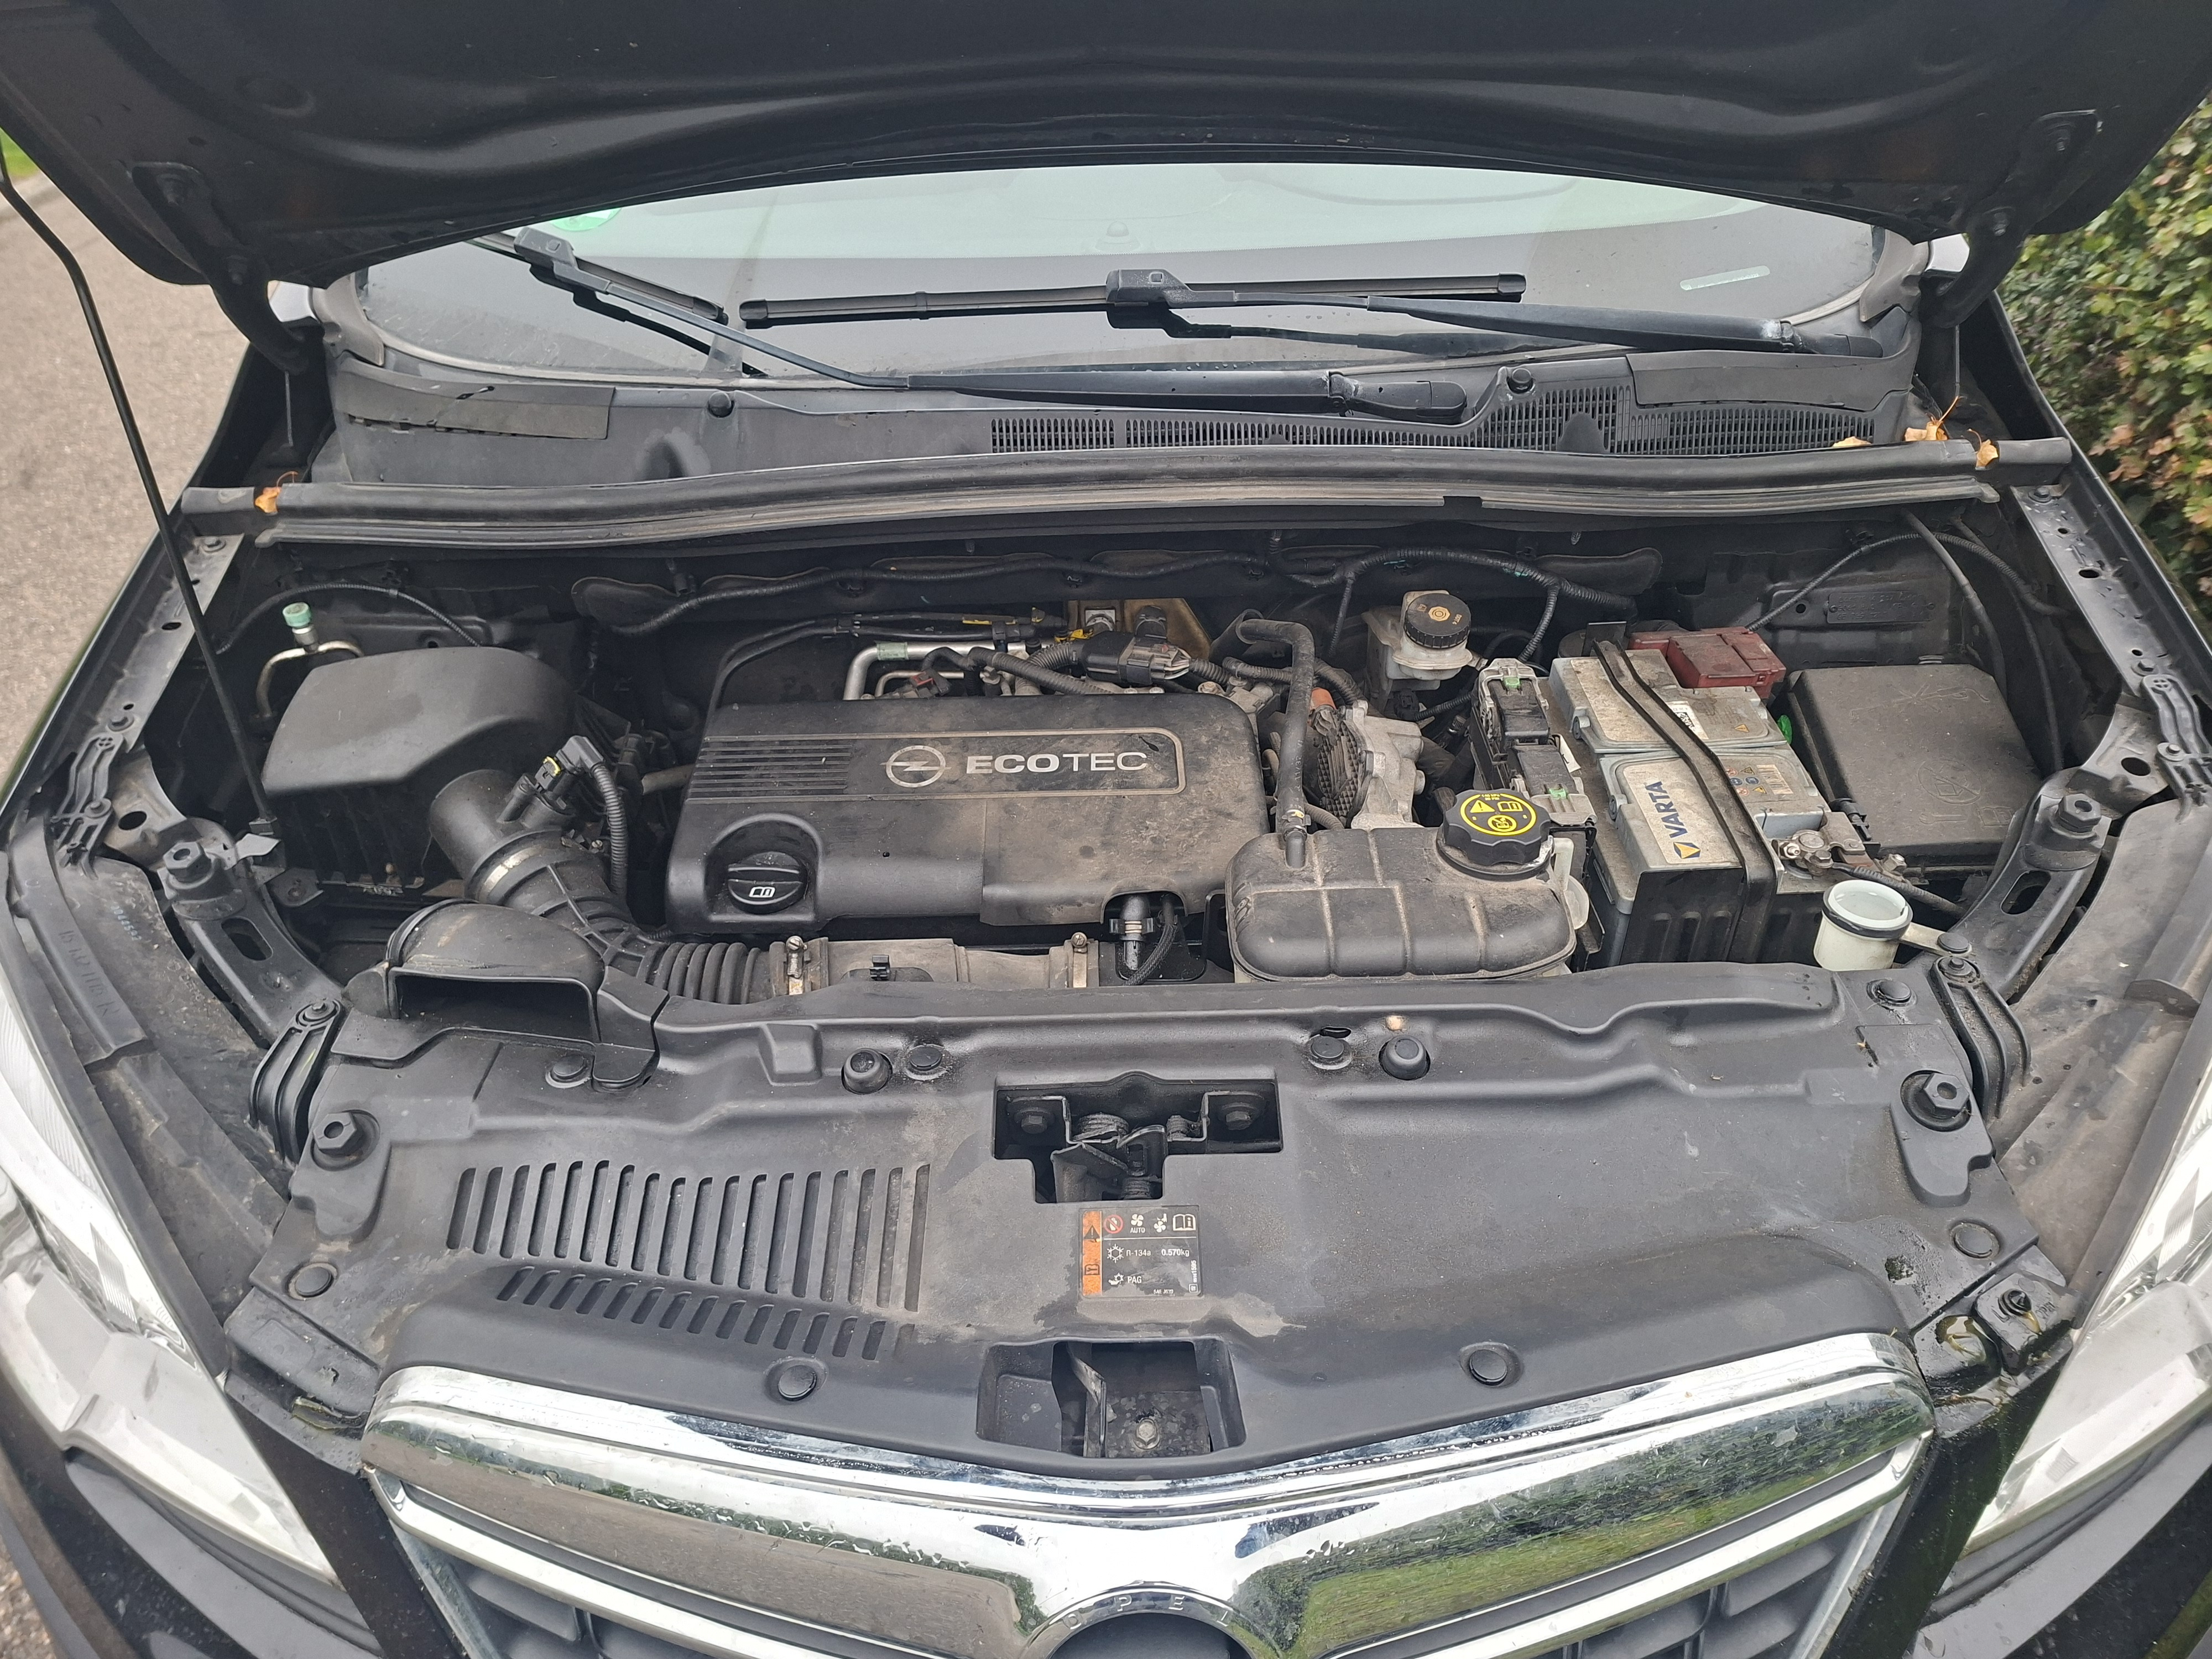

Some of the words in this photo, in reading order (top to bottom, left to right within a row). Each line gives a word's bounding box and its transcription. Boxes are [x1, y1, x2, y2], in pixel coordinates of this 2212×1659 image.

[966, 752, 1147, 774] ECOTEC
[1645, 781, 1688, 838] VARTA
[1161, 1249, 1190, 1257] 0.570kg
[1062, 1594, 1233, 1630] OPEL
